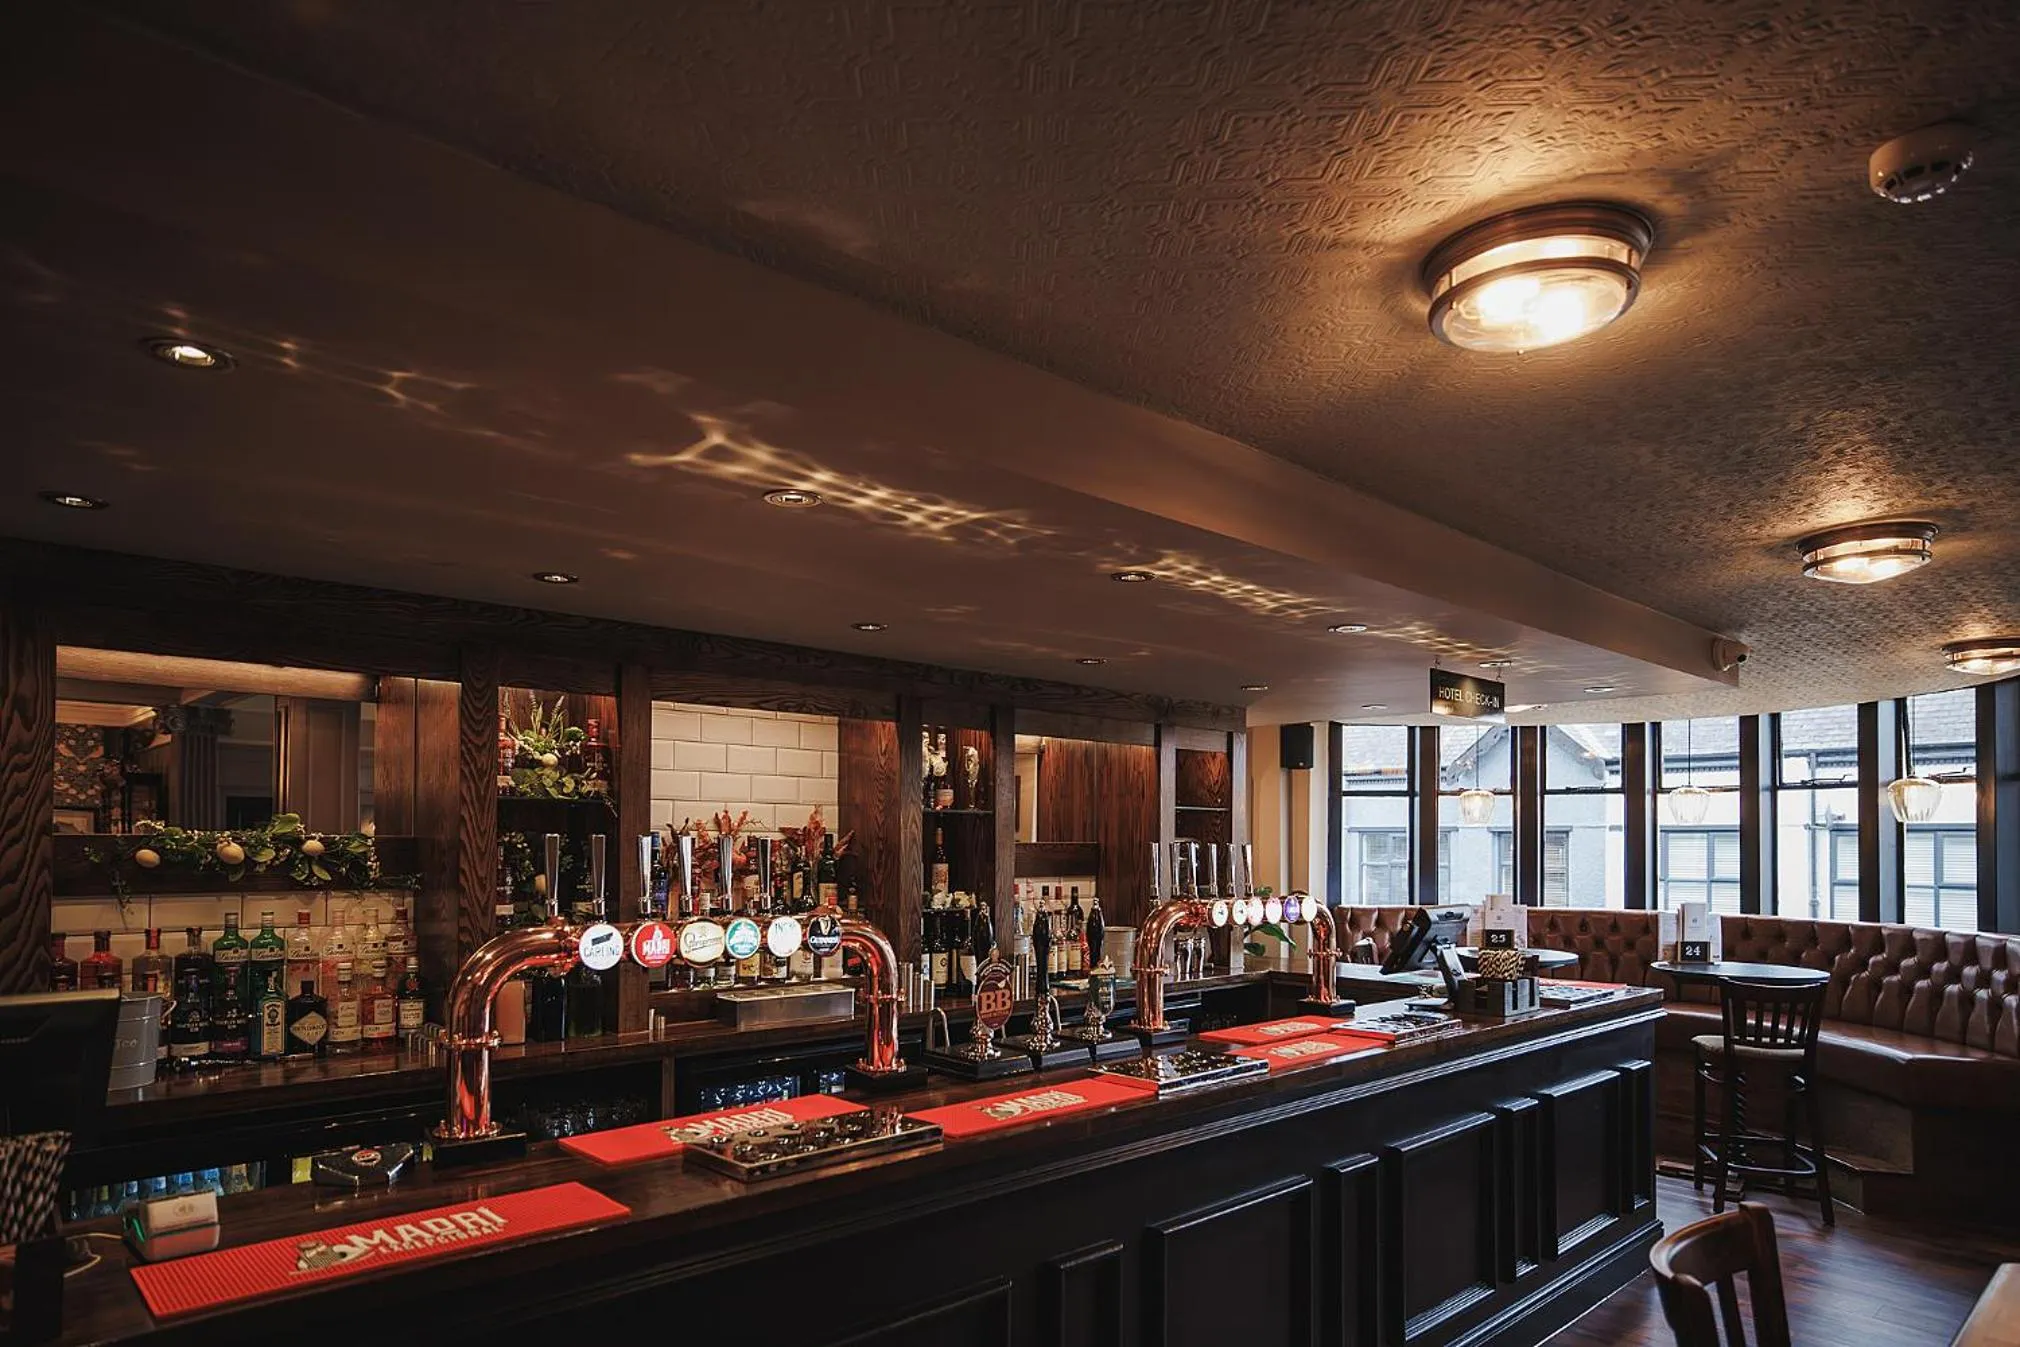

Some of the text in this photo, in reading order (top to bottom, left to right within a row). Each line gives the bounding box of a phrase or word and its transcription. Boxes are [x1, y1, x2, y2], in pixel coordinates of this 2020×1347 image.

[1439, 686, 1500, 708] HOTEL CHECK-IN
[1685, 945, 1701, 956] 24
[980, 988, 1011, 1013] BB
[345, 1206, 508, 1252] MADRI
